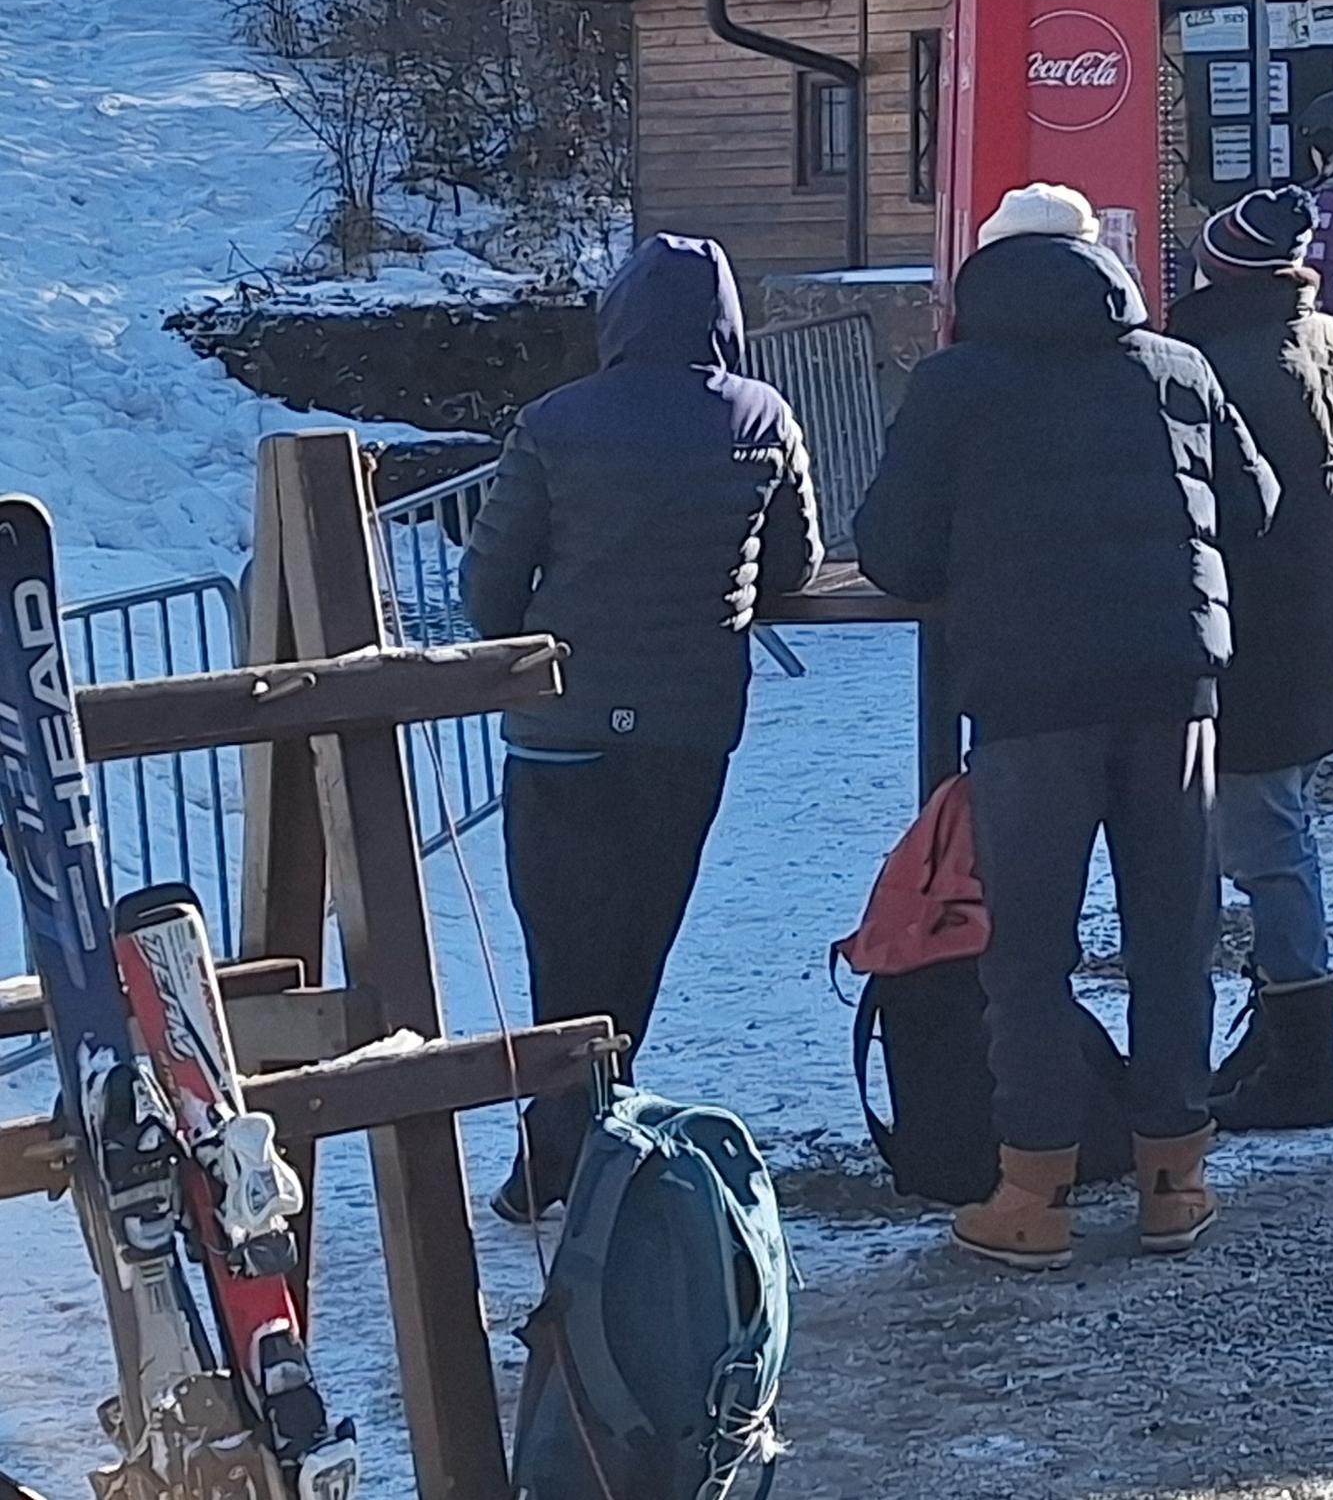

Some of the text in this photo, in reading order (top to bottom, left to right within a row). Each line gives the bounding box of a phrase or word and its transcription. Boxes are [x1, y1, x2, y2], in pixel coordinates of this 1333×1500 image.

[1028, 51, 1123, 87] oca-Cola
[14, 577, 97, 849] HEAD
[141, 932, 197, 1061] TEAM
